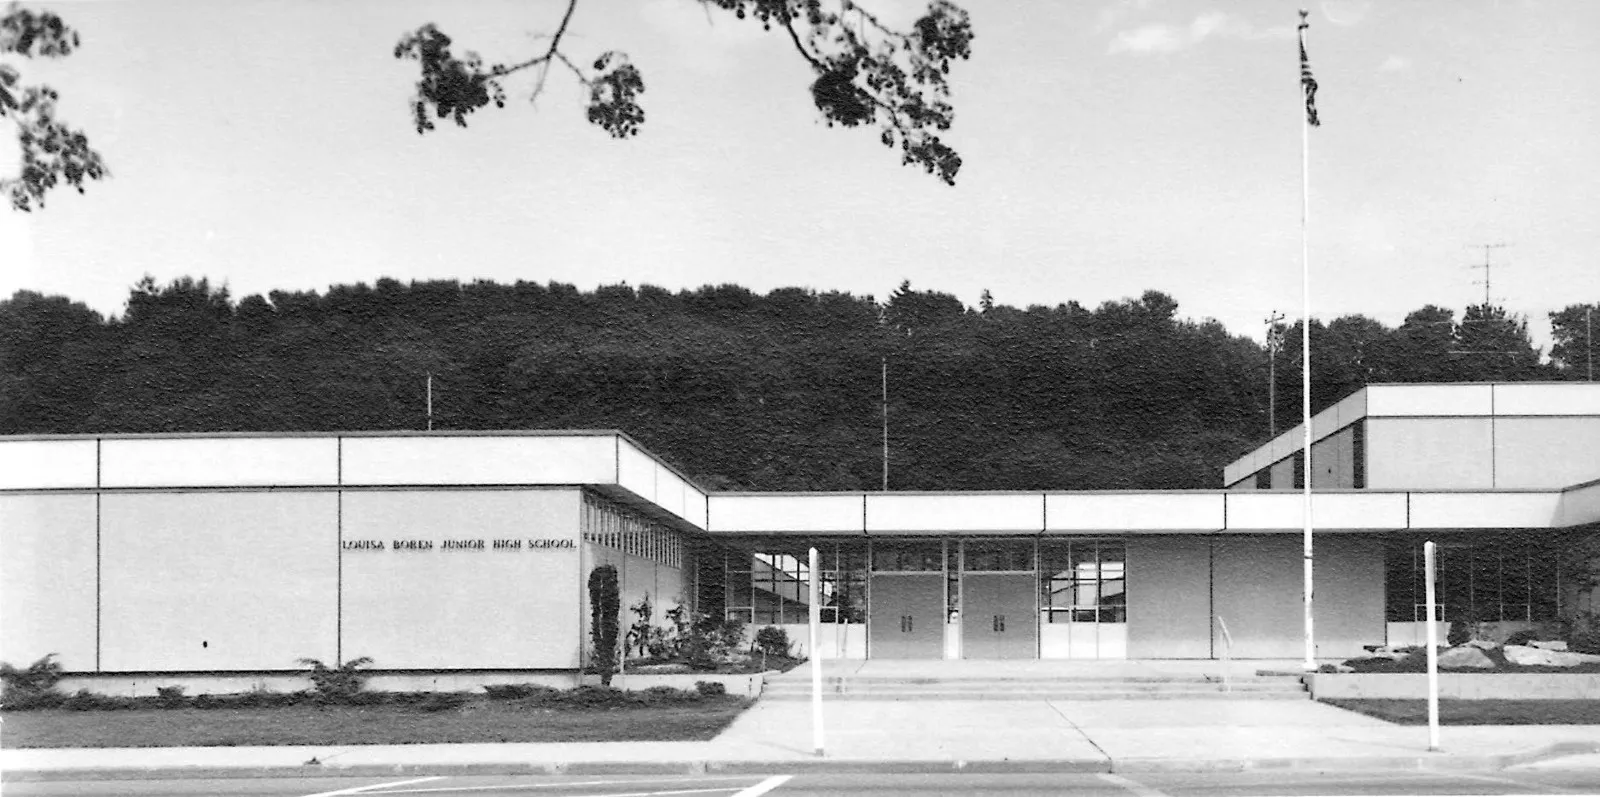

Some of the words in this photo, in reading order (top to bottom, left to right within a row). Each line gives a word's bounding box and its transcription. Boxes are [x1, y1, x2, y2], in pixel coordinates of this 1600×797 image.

[342, 540, 386, 550] LOUISA
[393, 539, 433, 550] BOREN
[440, 539, 486, 550] JUNIOR
[493, 539, 522, 549] HIGH
[528, 539, 577, 549] SCHOOL
